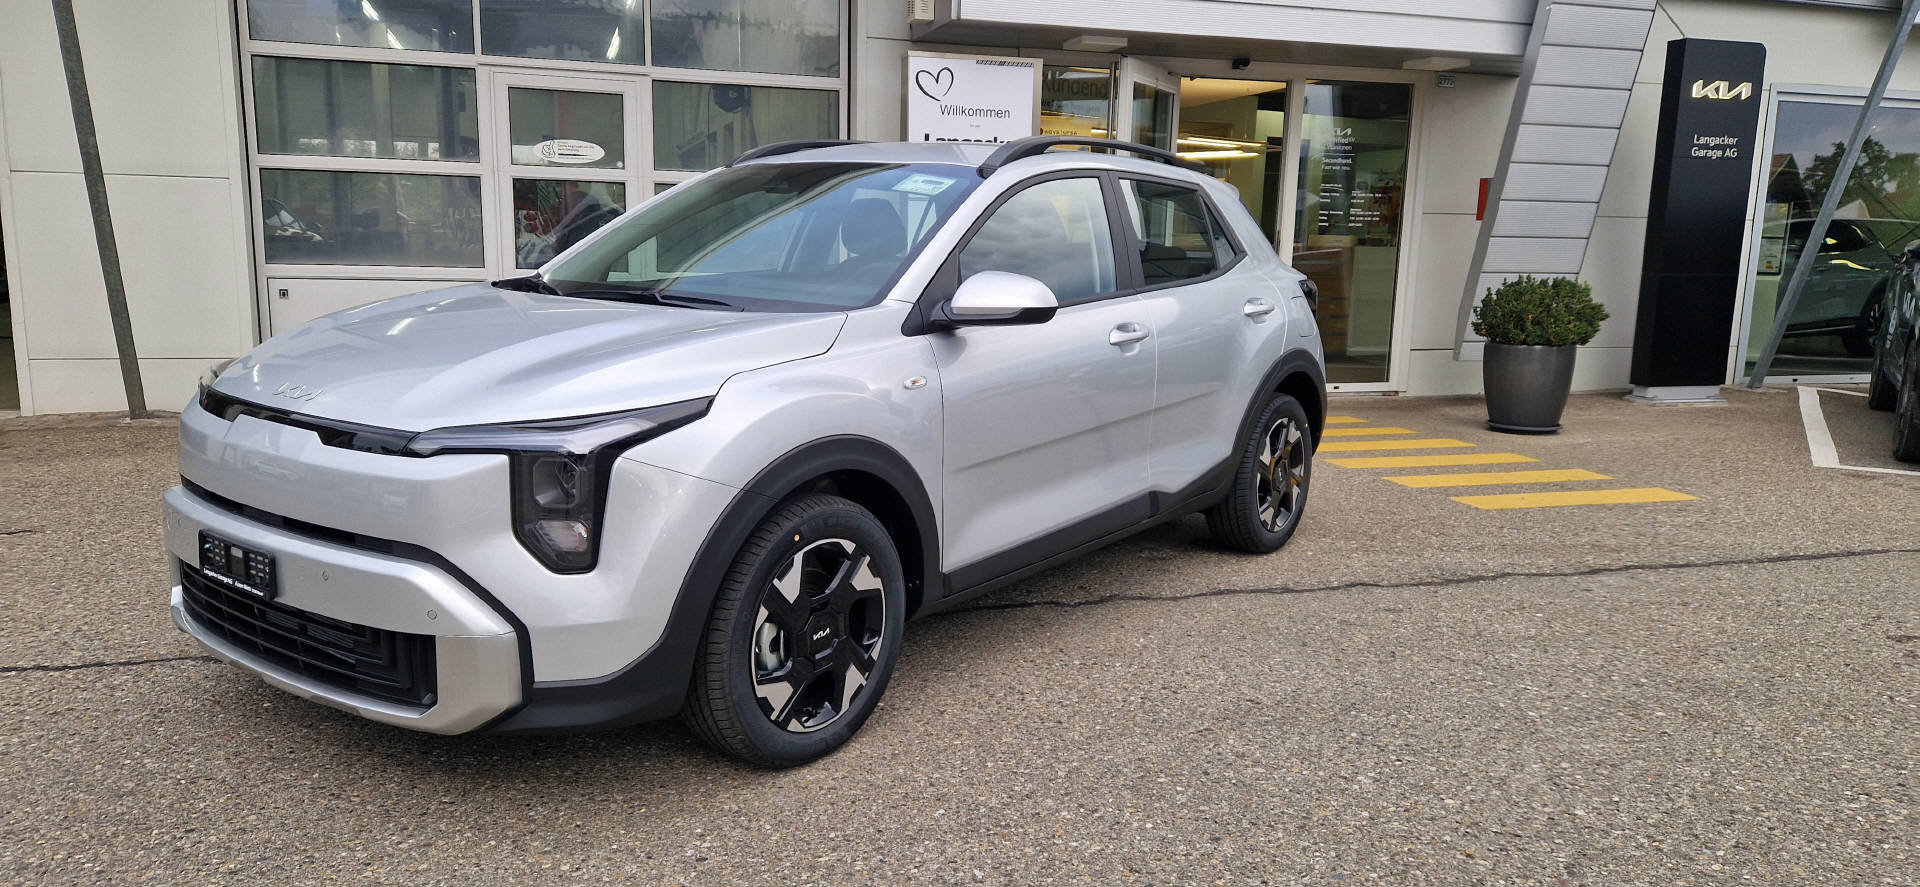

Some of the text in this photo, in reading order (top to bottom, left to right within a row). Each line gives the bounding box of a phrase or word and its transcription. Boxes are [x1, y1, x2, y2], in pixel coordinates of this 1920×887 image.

[1692, 80, 1752, 100] KIA
[940, 104, 1010, 118] Willkommen
[1694, 133, 1738, 147] Langacker
[1691, 146, 1738, 159] Garage AG
[272, 382, 324, 402] KIA
[813, 627, 830, 641] KIA
